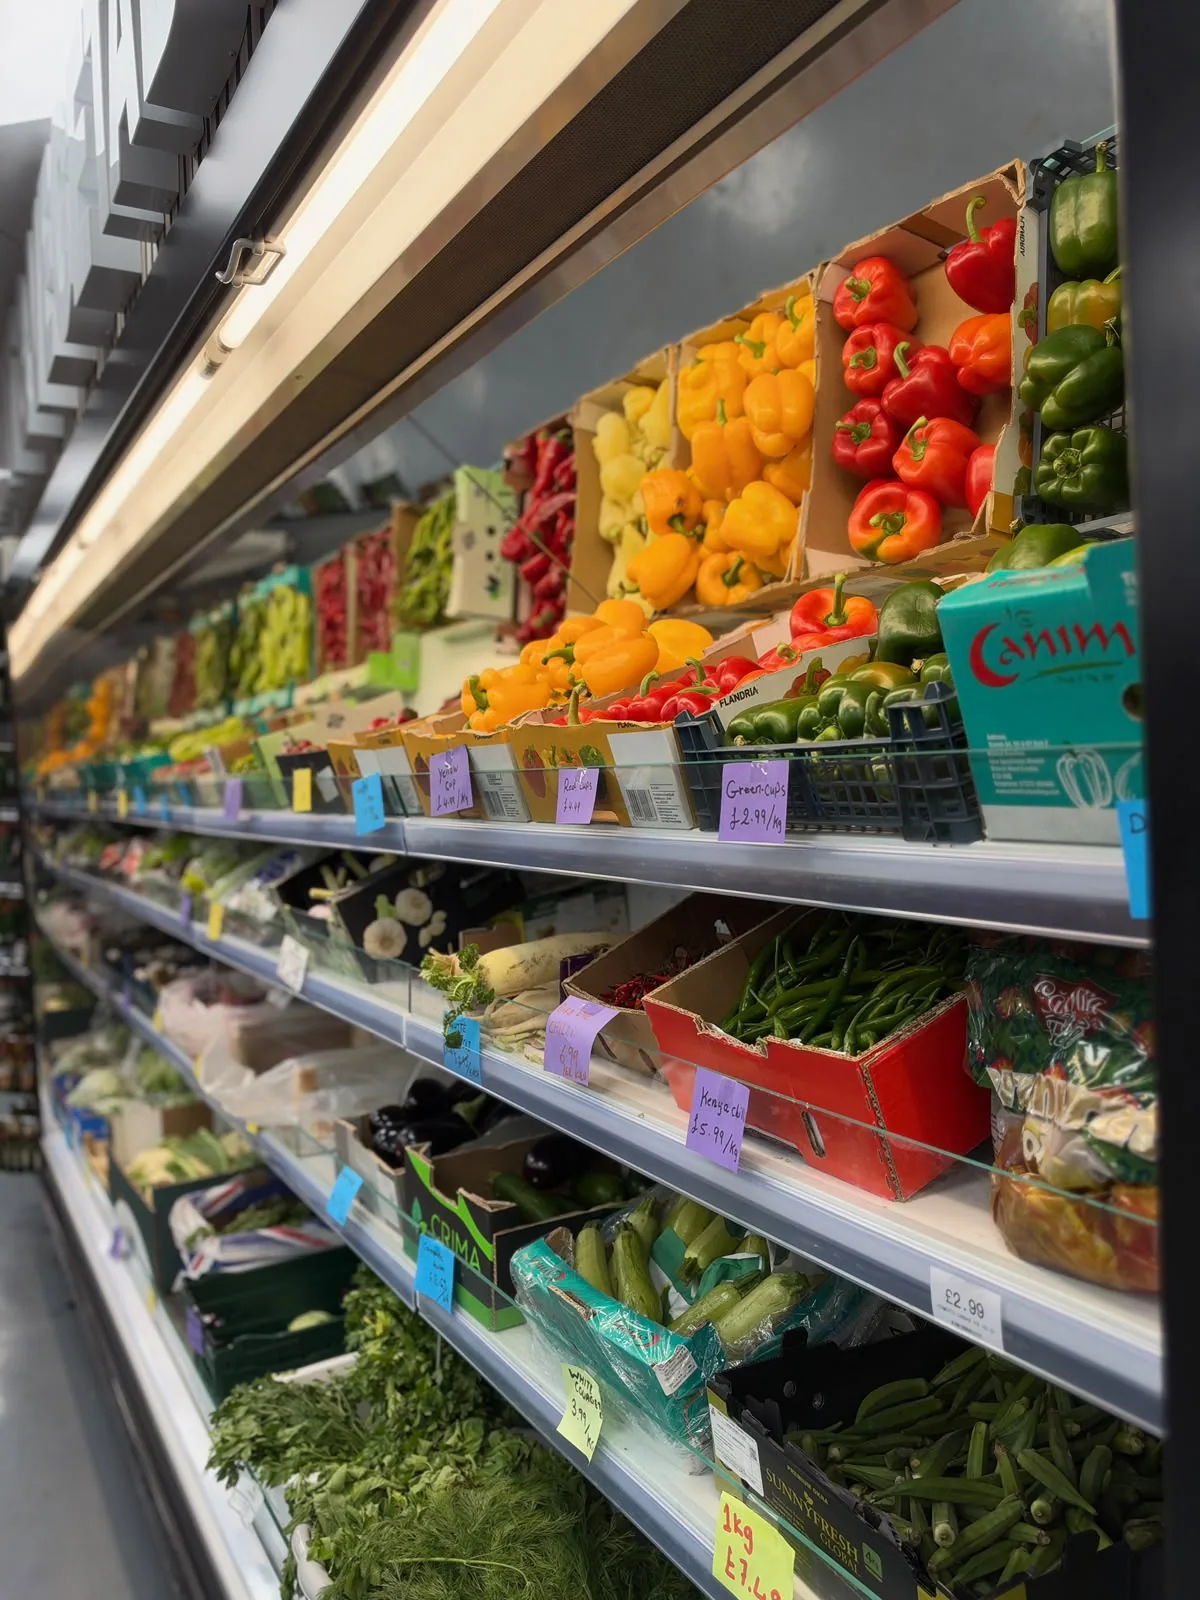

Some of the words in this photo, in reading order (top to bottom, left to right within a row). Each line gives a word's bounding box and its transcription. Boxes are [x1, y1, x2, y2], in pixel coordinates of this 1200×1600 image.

[719, 686, 759, 709] FLANDRIA
[700, 1086, 730, 1117] Kenya
[430, 1213, 481, 1272] CRIMA
[944, 1287, 985, 1320] £2.99
[568, 1368, 593, 1395] WHITE
[723, 1503, 753, 1556] 1kg
[819, 1531, 862, 1578] GLOBAL
